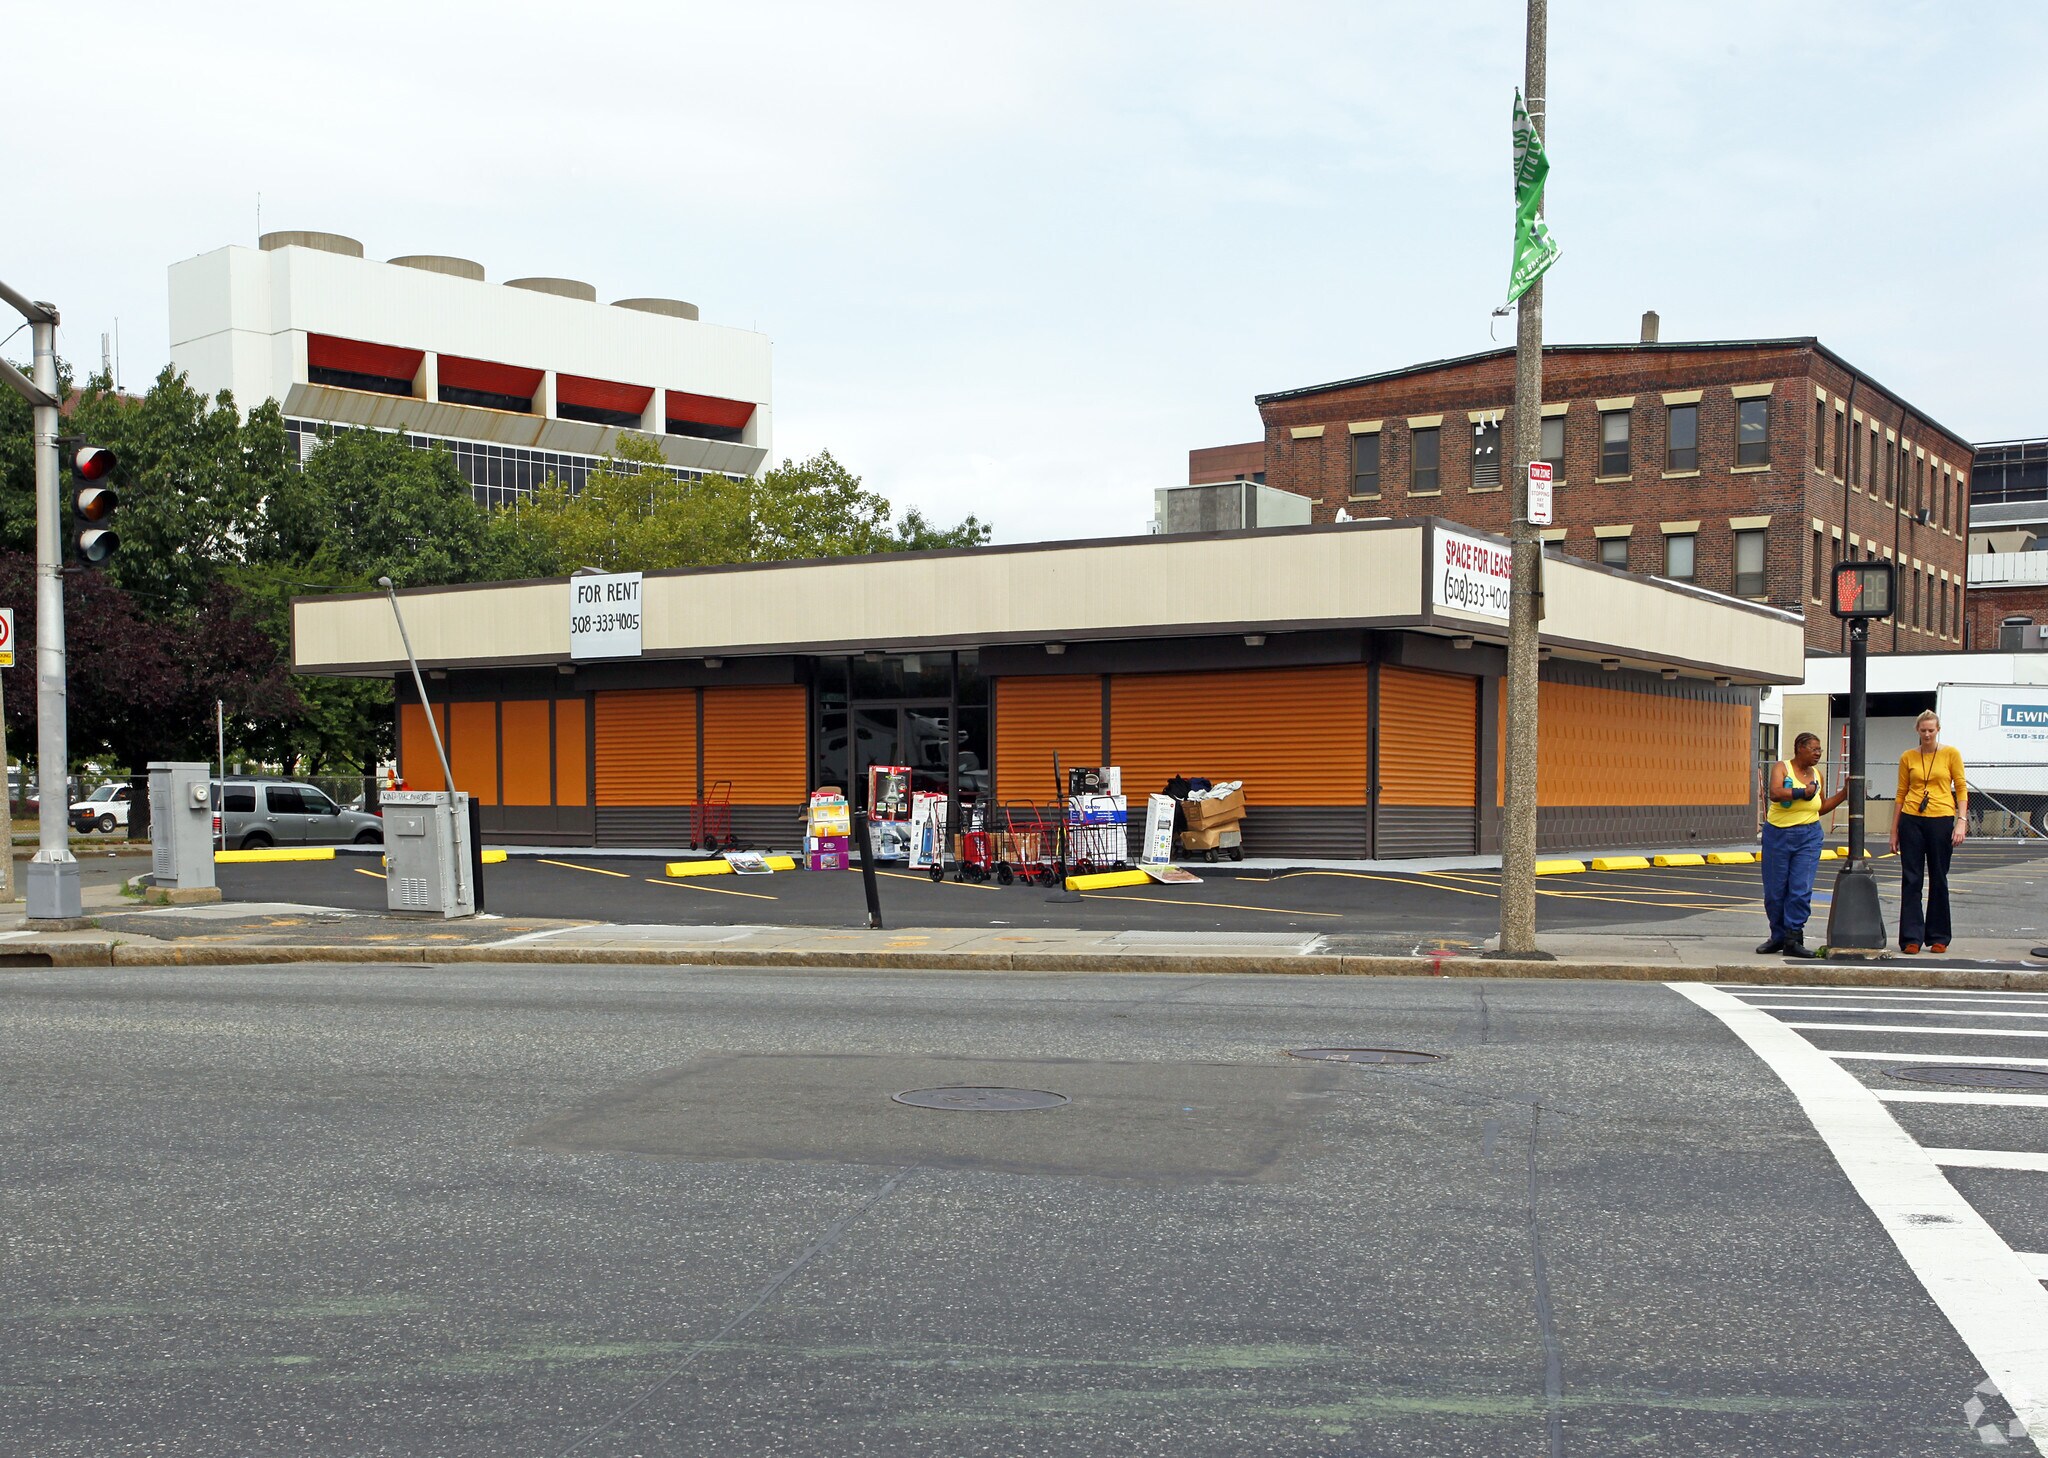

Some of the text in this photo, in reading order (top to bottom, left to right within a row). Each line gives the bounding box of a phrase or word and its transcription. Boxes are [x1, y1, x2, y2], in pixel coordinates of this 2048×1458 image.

[1536, 482, 1545, 490] NO
[1446, 539, 1471, 570] SPACE
[1473, 546, 1488, 575] FOR
[578, 581, 640, 604] FOR RENT
[571, 612, 640, 634] 508-333-4005
